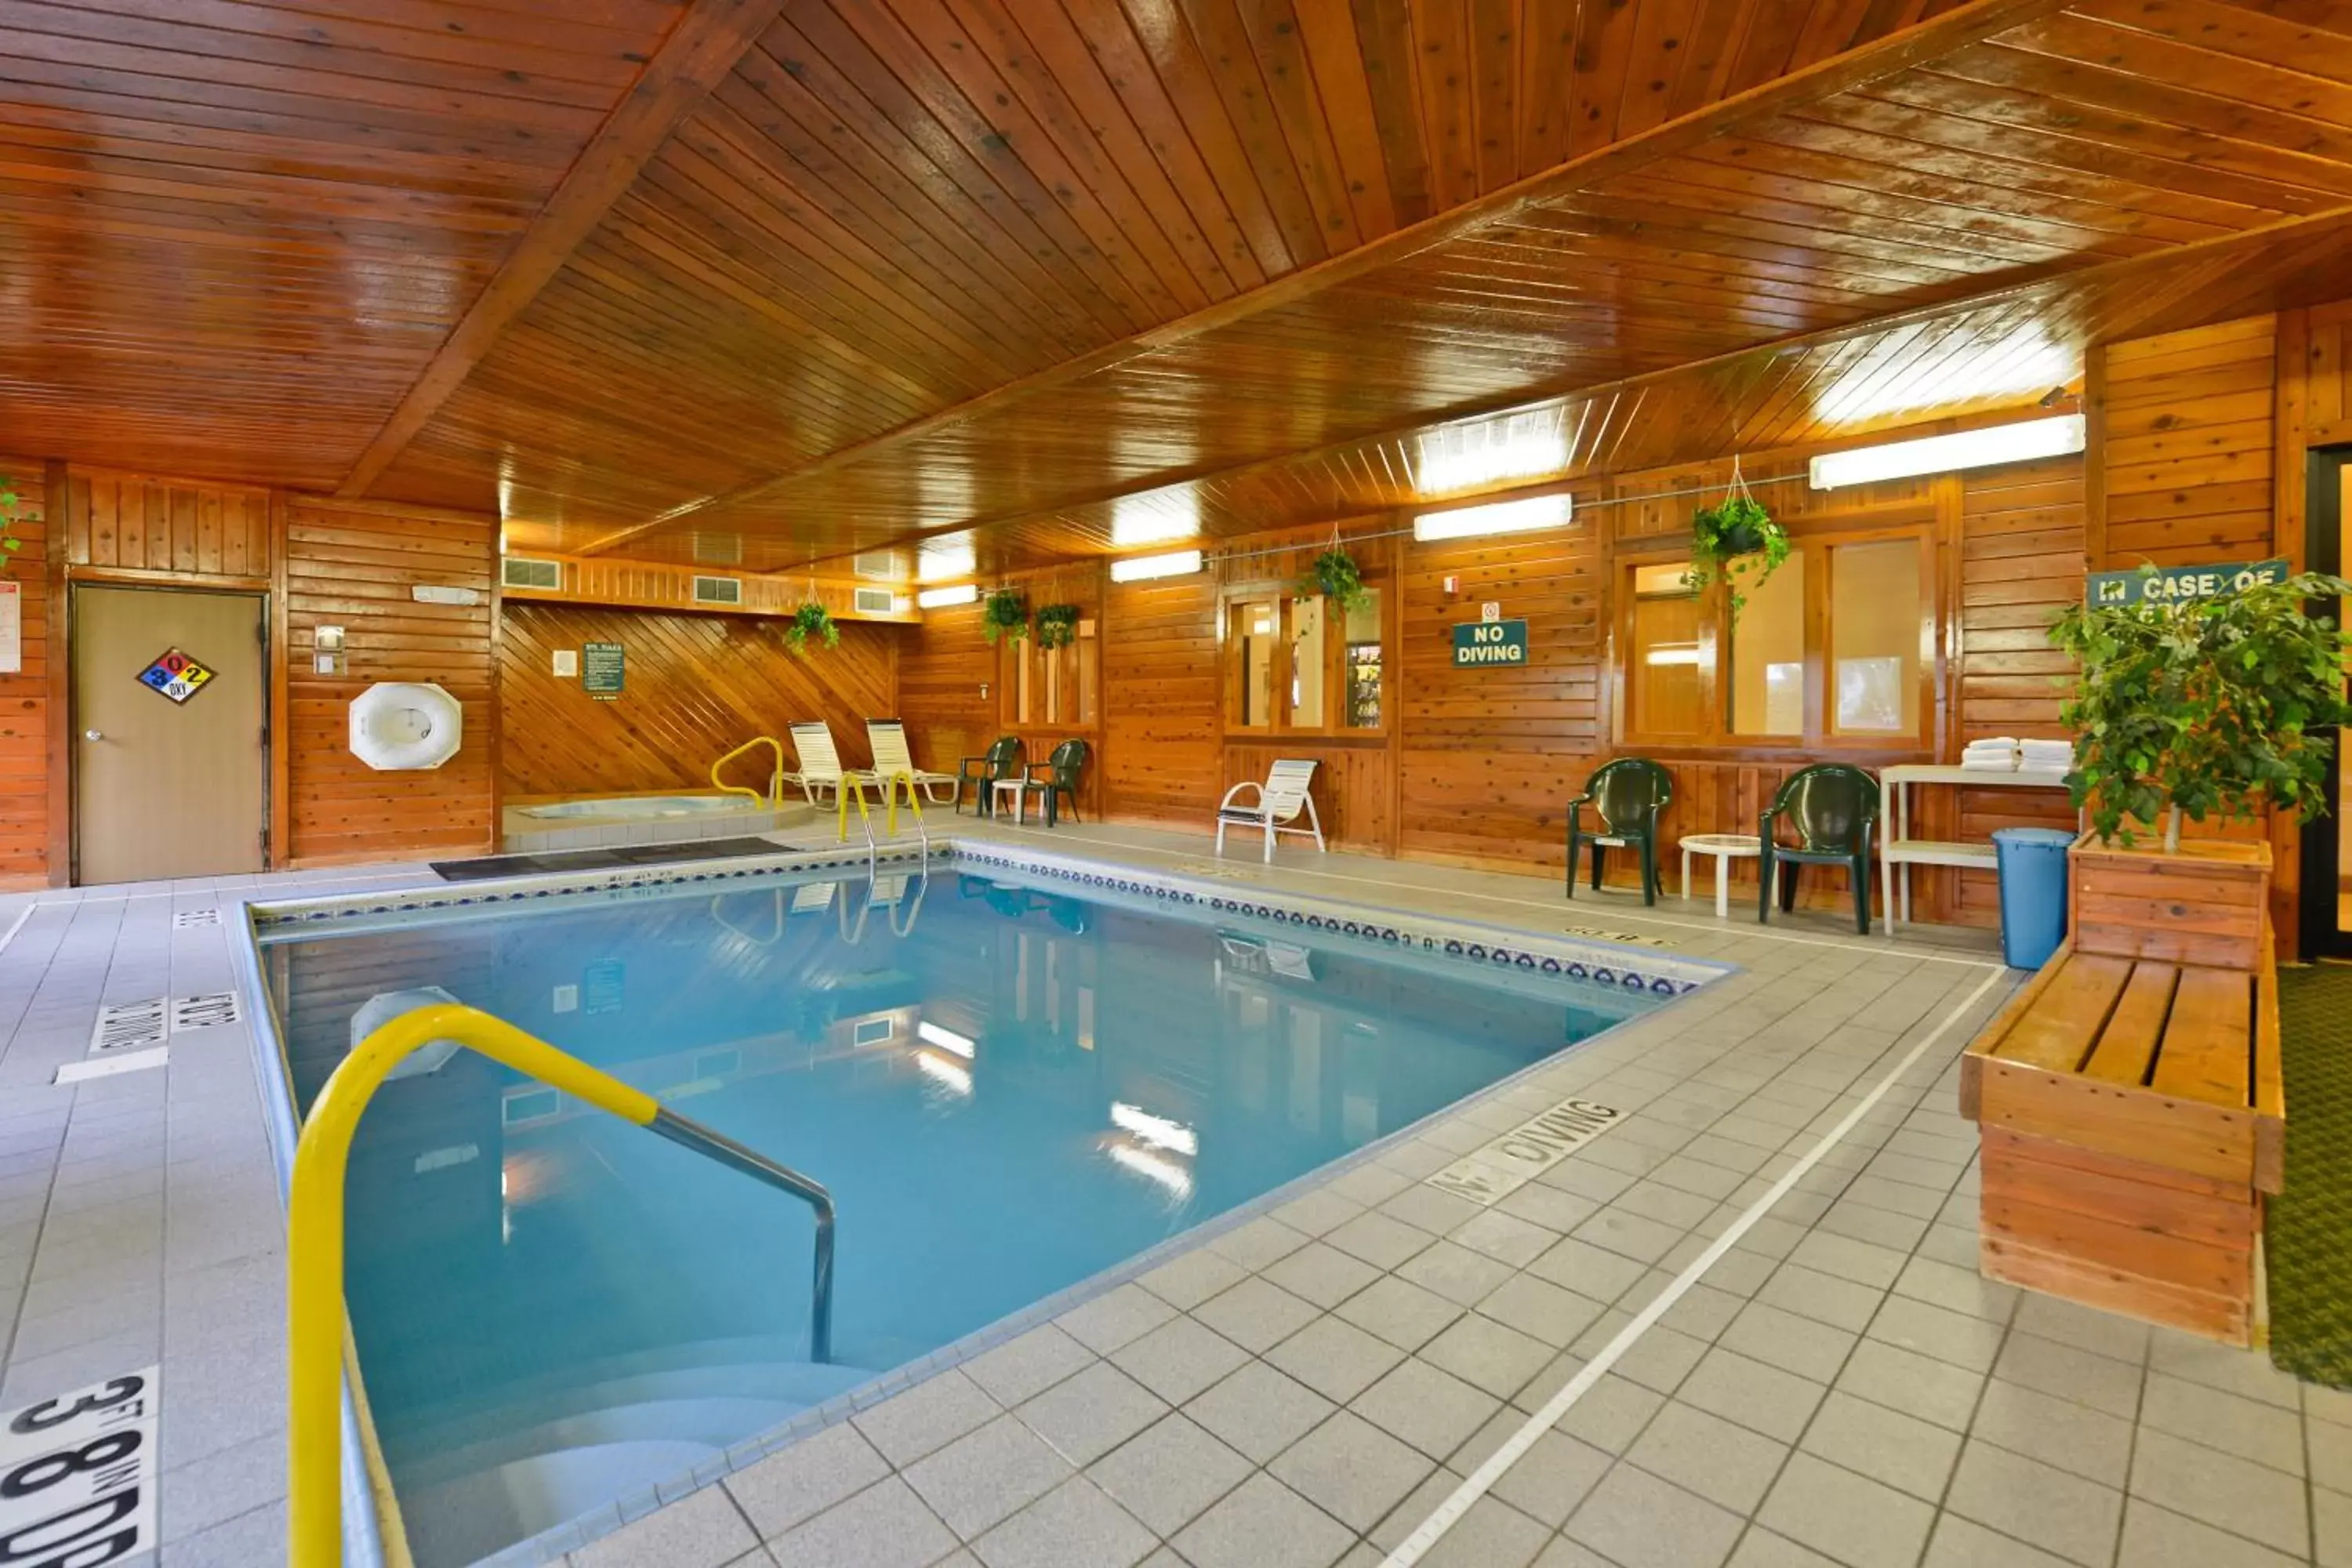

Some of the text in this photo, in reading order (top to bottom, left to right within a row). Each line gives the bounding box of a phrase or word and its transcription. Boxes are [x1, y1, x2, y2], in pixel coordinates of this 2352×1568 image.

[2143, 573, 2216, 599] CASE
[1475, 626, 1504, 642] NO
[1458, 644, 1522, 662] DIVING
[187, 667, 201, 682] 2
